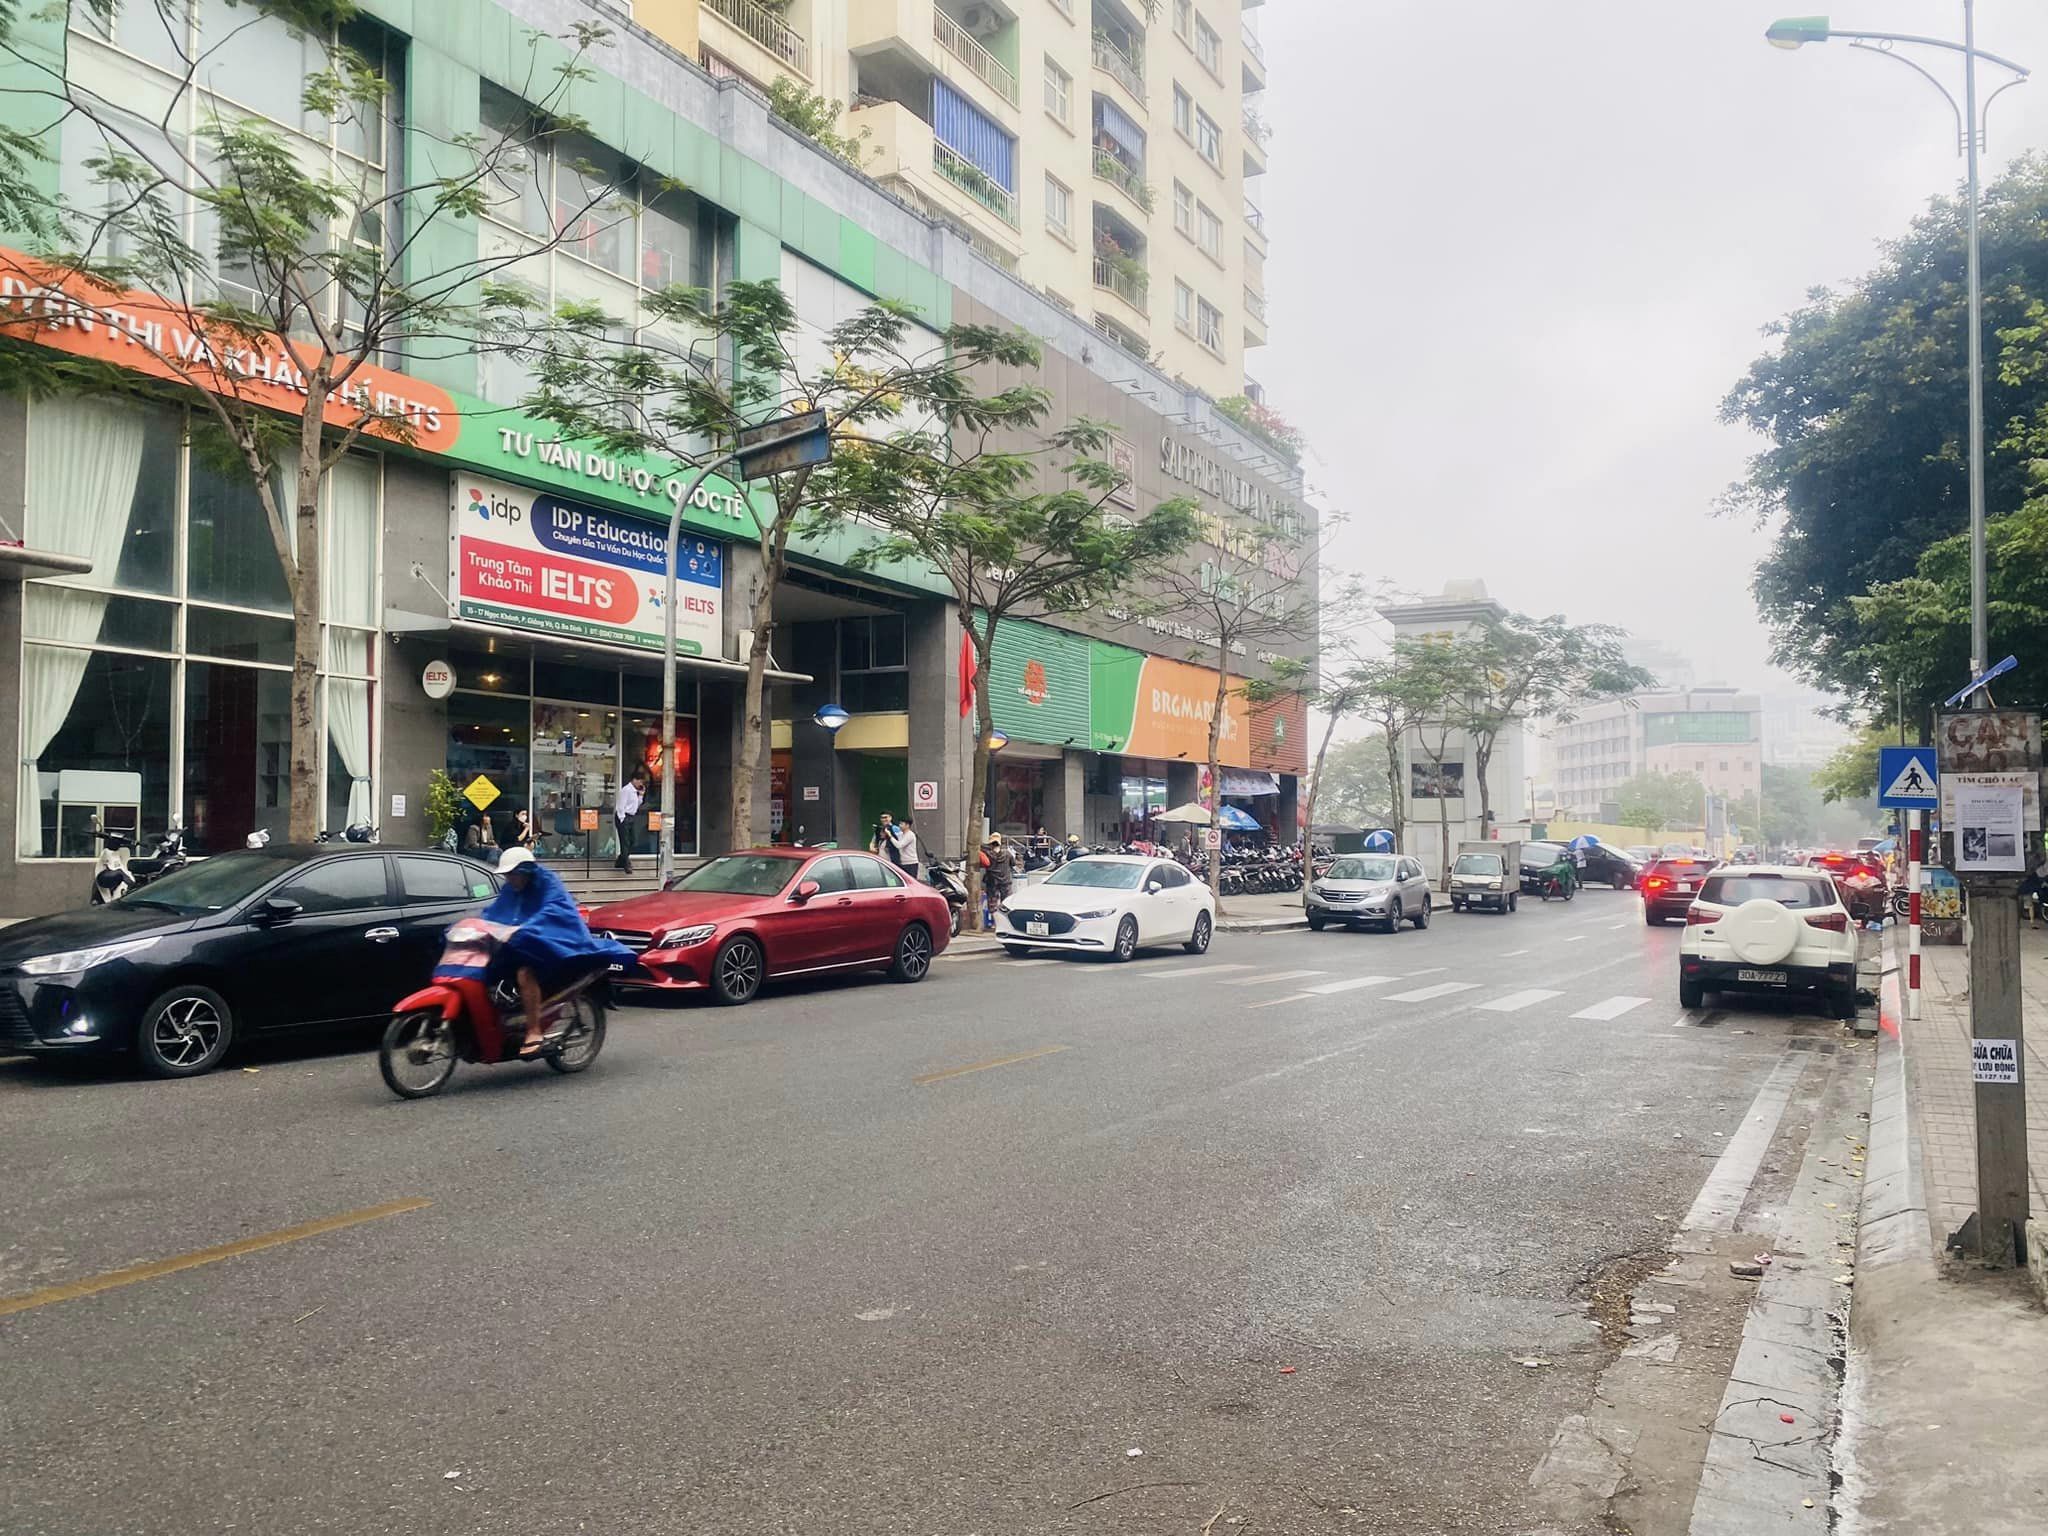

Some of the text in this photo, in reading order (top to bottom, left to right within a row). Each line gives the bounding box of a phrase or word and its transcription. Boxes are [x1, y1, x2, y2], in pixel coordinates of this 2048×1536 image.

[102, 307, 162, 352] THI
[375, 390, 441, 432] IELTS
[498, 428, 533, 457] TƯ
[585, 453, 616, 481] DU
[618, 463, 662, 497] HỌC
[491, 494, 521, 525] idp
[552, 506, 583, 531] IDP
[468, 552, 533, 577] Trung Tâm
[478, 571, 513, 590] Khảo
[541, 567, 613, 609] IELTS
[684, 595, 715, 615] IELTS
[426, 672, 448, 681] IELTS
[1990, 1044, 2013, 1061] CHỮA
